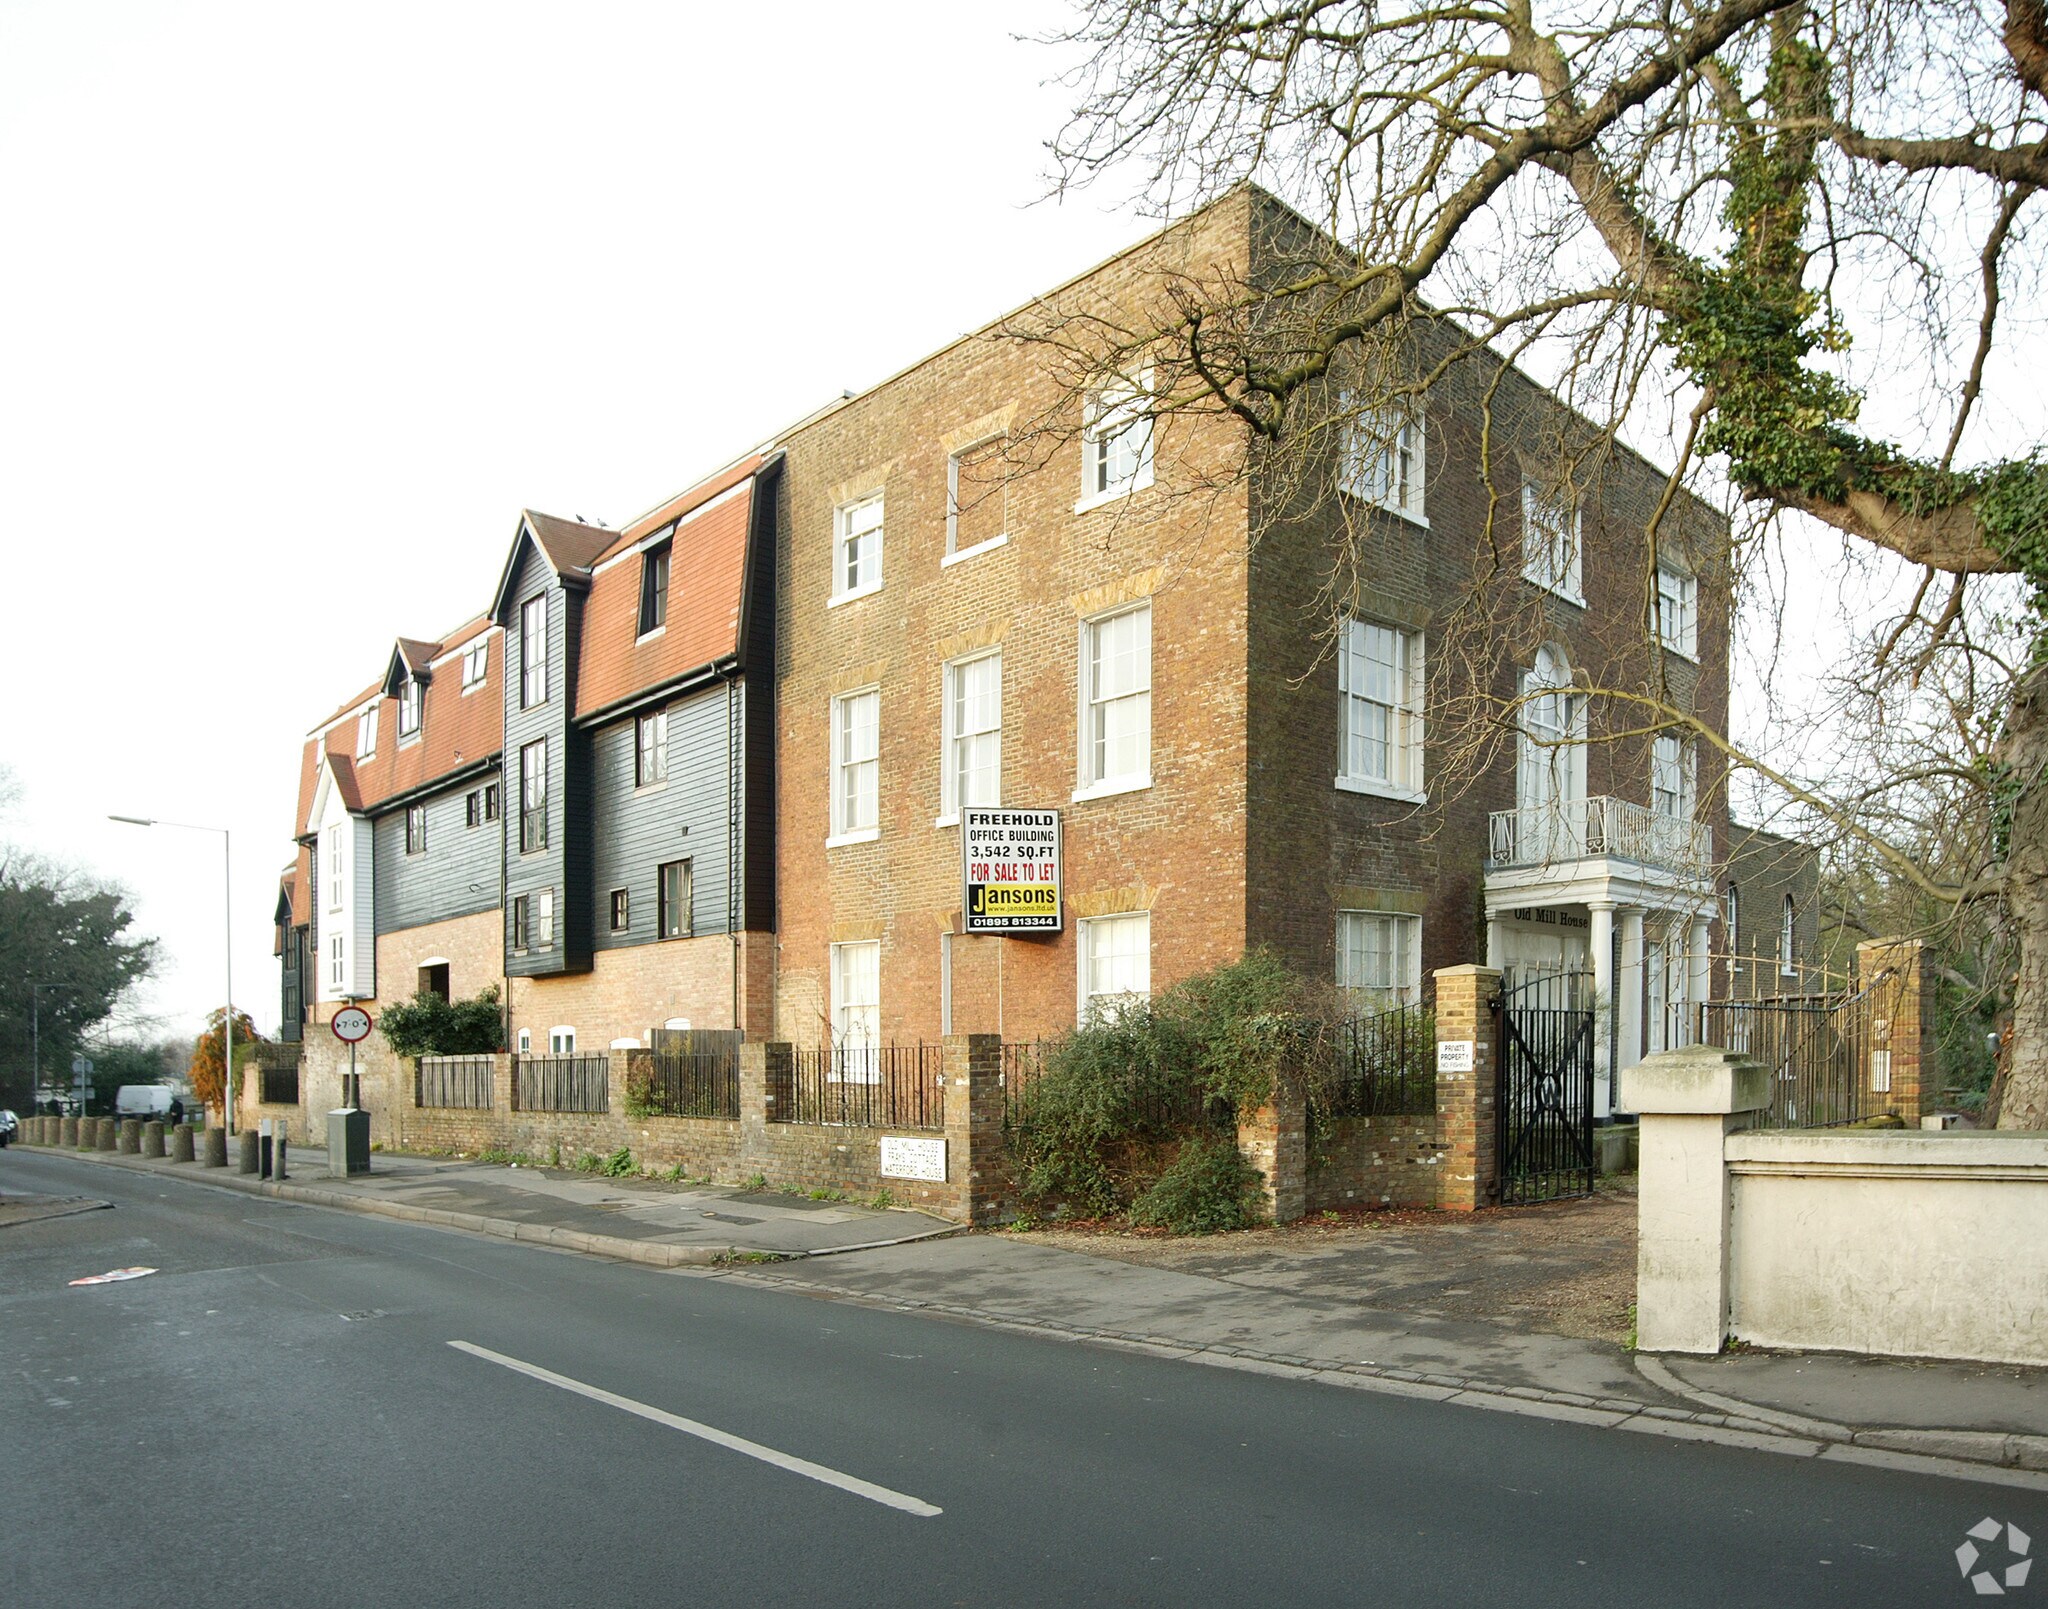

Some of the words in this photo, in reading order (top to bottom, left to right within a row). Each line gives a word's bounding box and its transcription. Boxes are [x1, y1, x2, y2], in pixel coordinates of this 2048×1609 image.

[970, 814, 1053, 826] FREEHOLD
[970, 830, 1004, 841] OFFICE
[1009, 830, 1054, 842] BUILDING
[971, 846, 1010, 859] 3,542
[1017, 846, 1054, 860] SQ.FT
[971, 863, 989, 881] FOR
[994, 863, 1018, 881] SALE
[1023, 863, 1034, 881] TO
[1039, 863, 1054, 881] LET
[973, 889, 1055, 912] Jansons
[988, 905, 1055, 913] www.jansons.ltd.uk
[974, 918, 1009, 926] 01895
[1012, 918, 1053, 926] 813344
[1514, 907, 1531, 920] Old
[1535, 908, 1556, 924] Mill
[1560, 911, 1588, 928] House
[1440, 1053, 1469, 1061] PROPERTY
